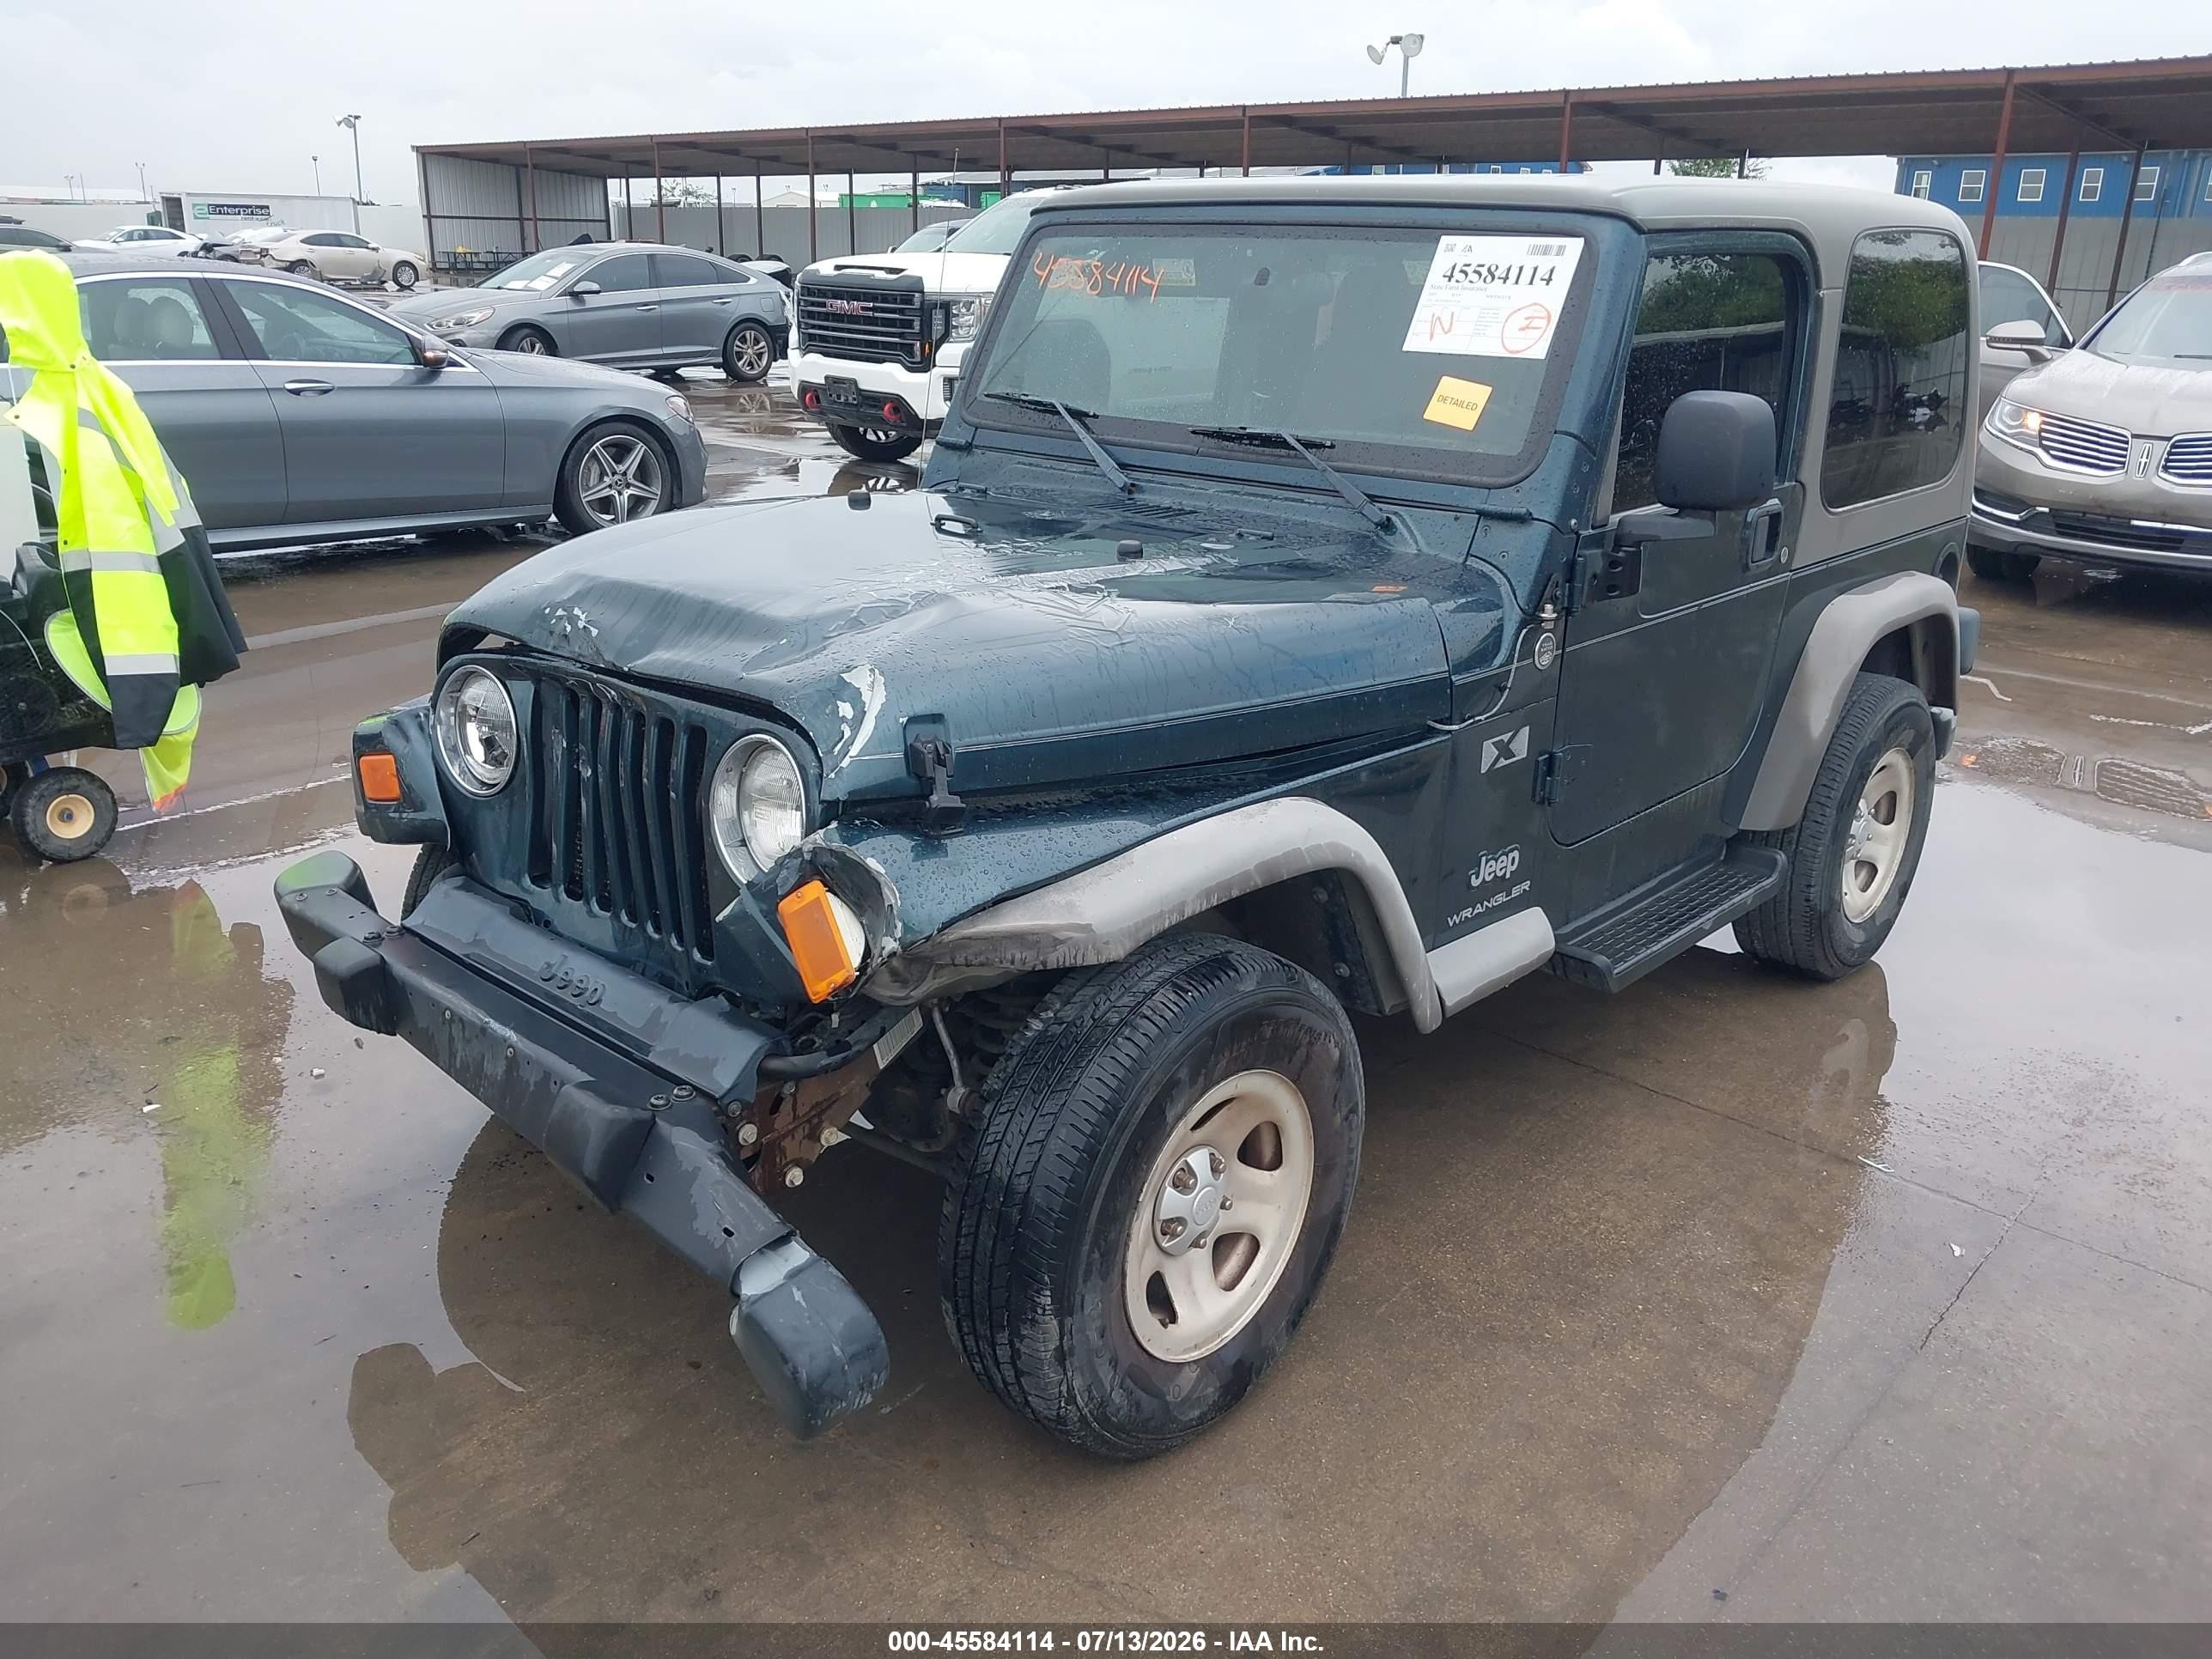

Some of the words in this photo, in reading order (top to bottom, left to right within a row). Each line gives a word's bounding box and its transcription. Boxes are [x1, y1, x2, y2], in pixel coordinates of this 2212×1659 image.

[209, 205, 270, 216] Enterprise
[1034, 252, 1164, 303] 45584114
[1442, 262, 1556, 286] 45584114
[826, 299, 873, 317] GMC
[1437, 394, 1479, 411] DETAILED
[1483, 727, 1527, 773] X
[1469, 848, 1520, 887] Jeep
[1447, 880, 1531, 927] WRANGLER
[539, 954, 606, 1008] Jeep
